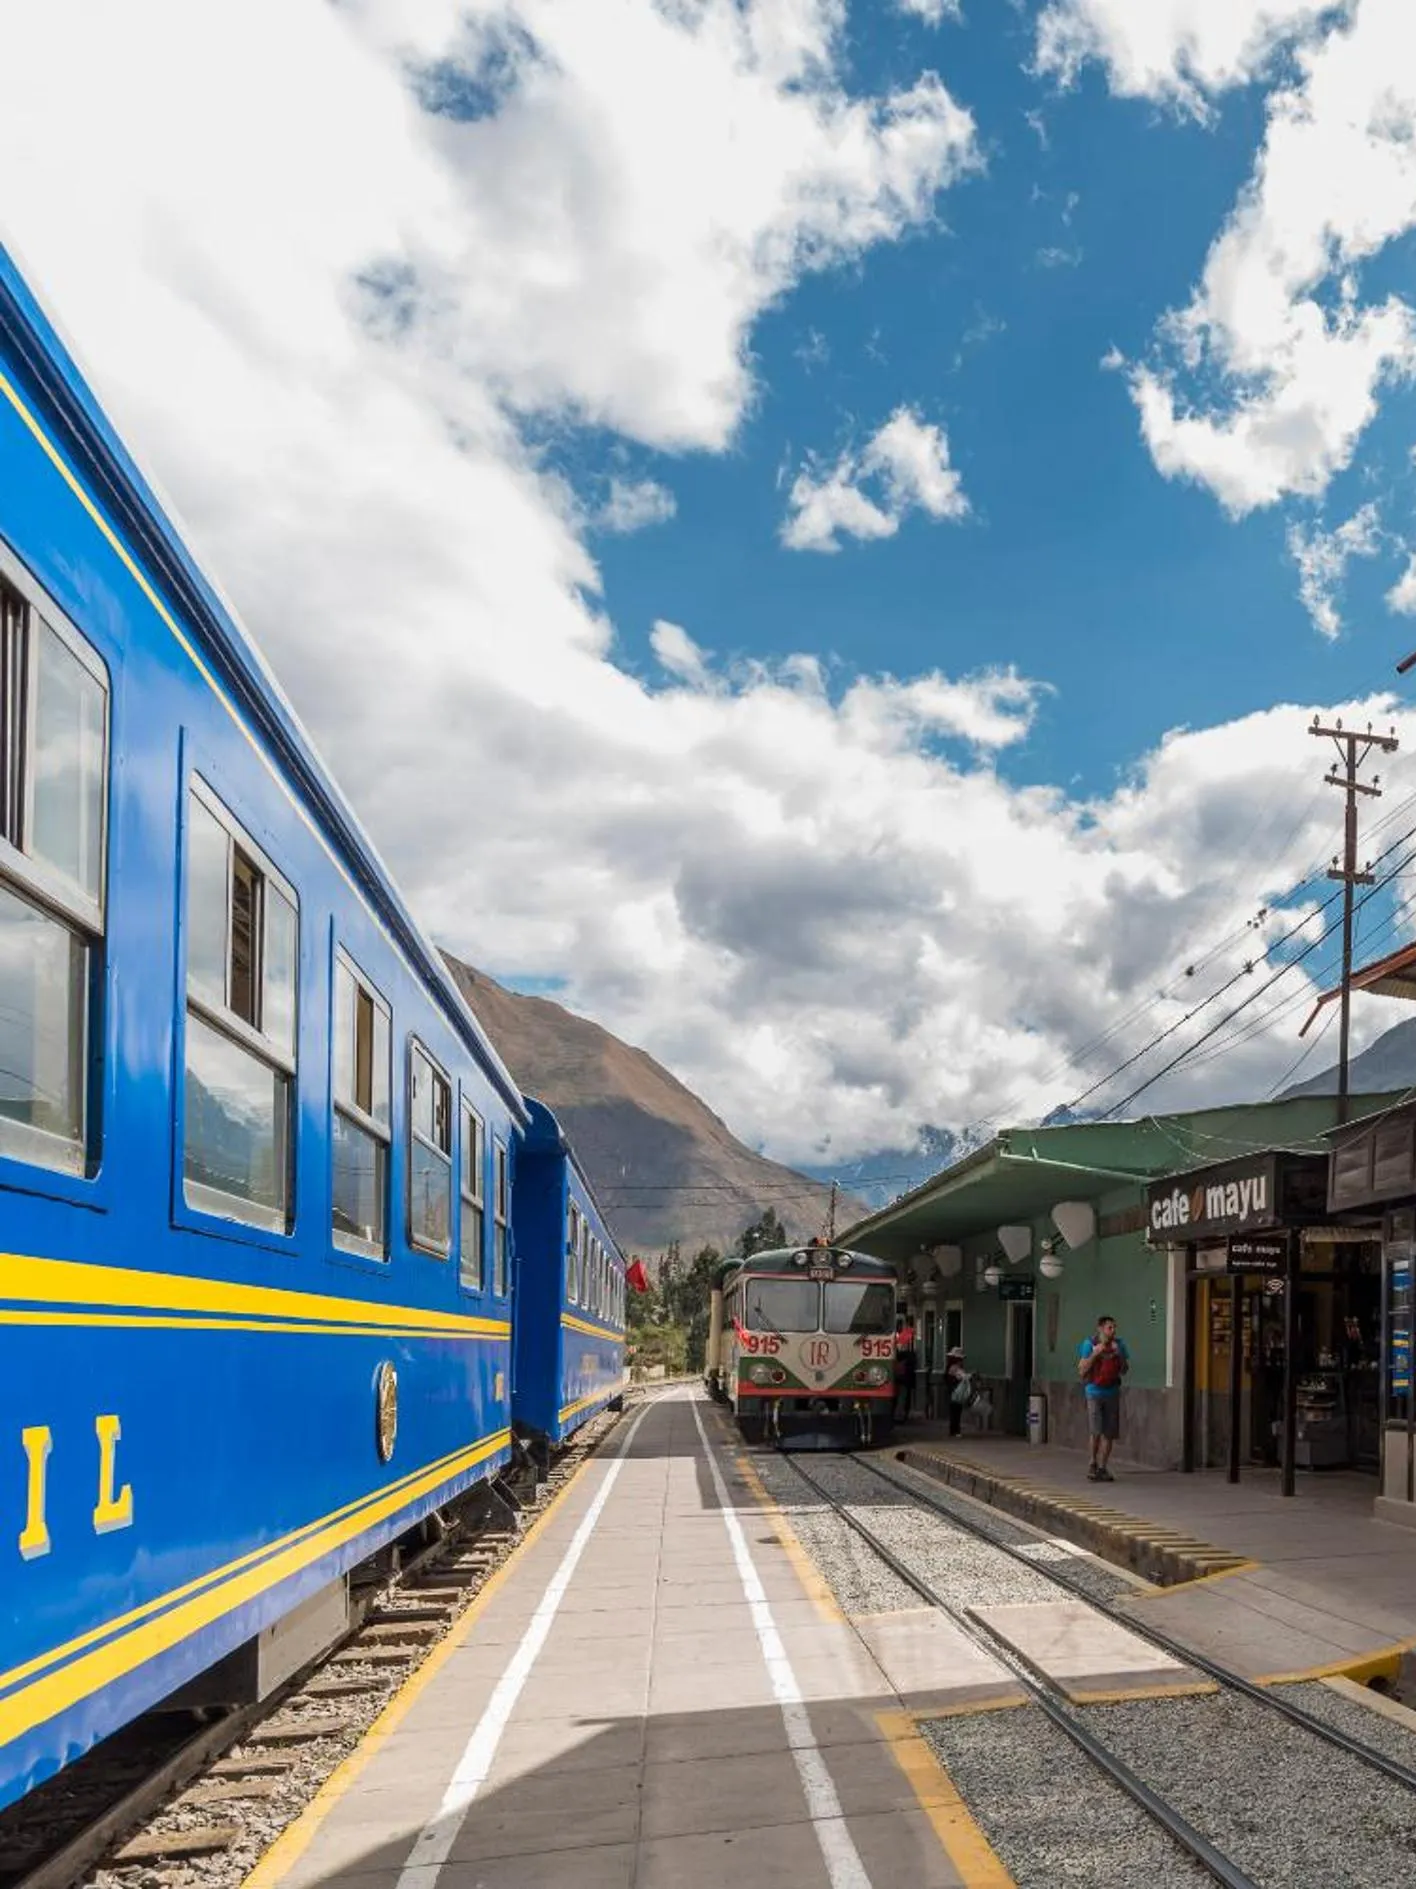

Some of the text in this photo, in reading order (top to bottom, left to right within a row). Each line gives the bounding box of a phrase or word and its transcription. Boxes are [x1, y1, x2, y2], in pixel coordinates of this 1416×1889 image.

[1151, 1175, 1266, 1230] cafe mayu
[747, 1335, 780, 1355] 915
[861, 1339, 892, 1358] 915
